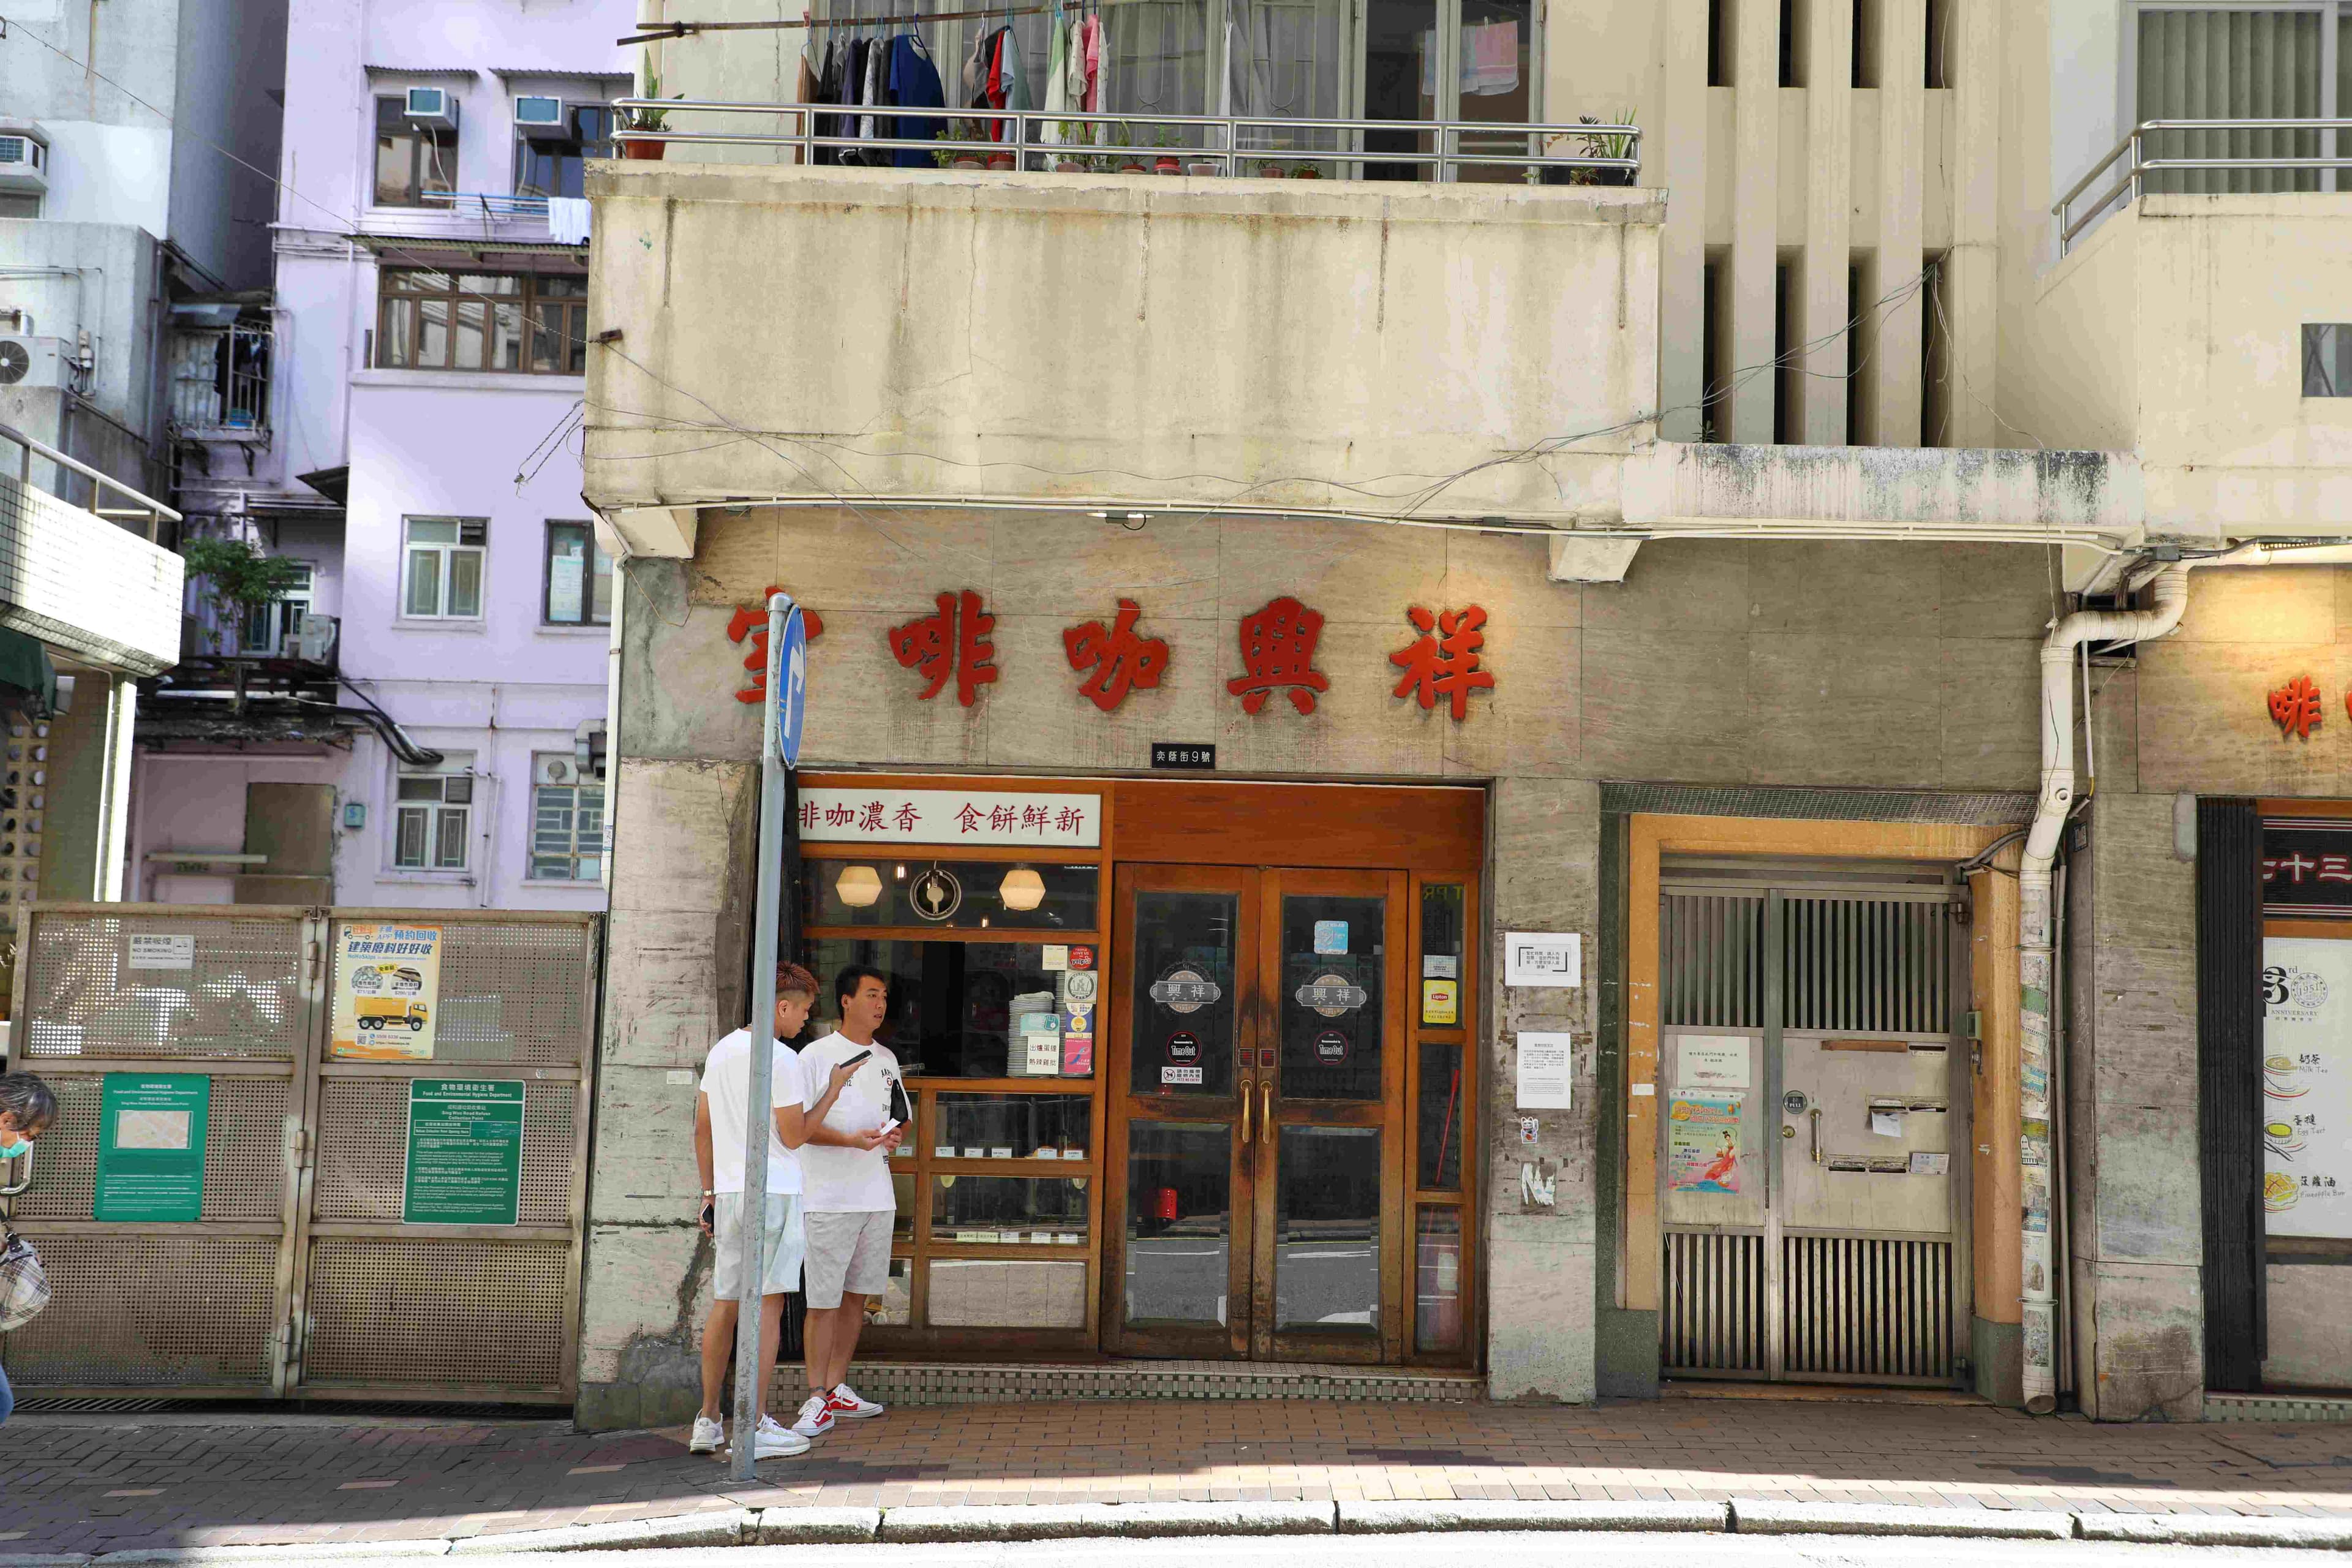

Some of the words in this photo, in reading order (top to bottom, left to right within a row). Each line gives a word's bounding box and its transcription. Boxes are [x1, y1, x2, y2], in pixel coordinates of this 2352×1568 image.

[2268, 674, 2352, 738] 啡
[1156, 750, 1210, 763] 奕蔭街9號
[394, 930, 437, 941] 預約回收
[347, 941, 432, 955] 建築廢料好好收
[2299, 983, 2319, 996] 1951
[2299, 1054, 2320, 1065] 奶茶
